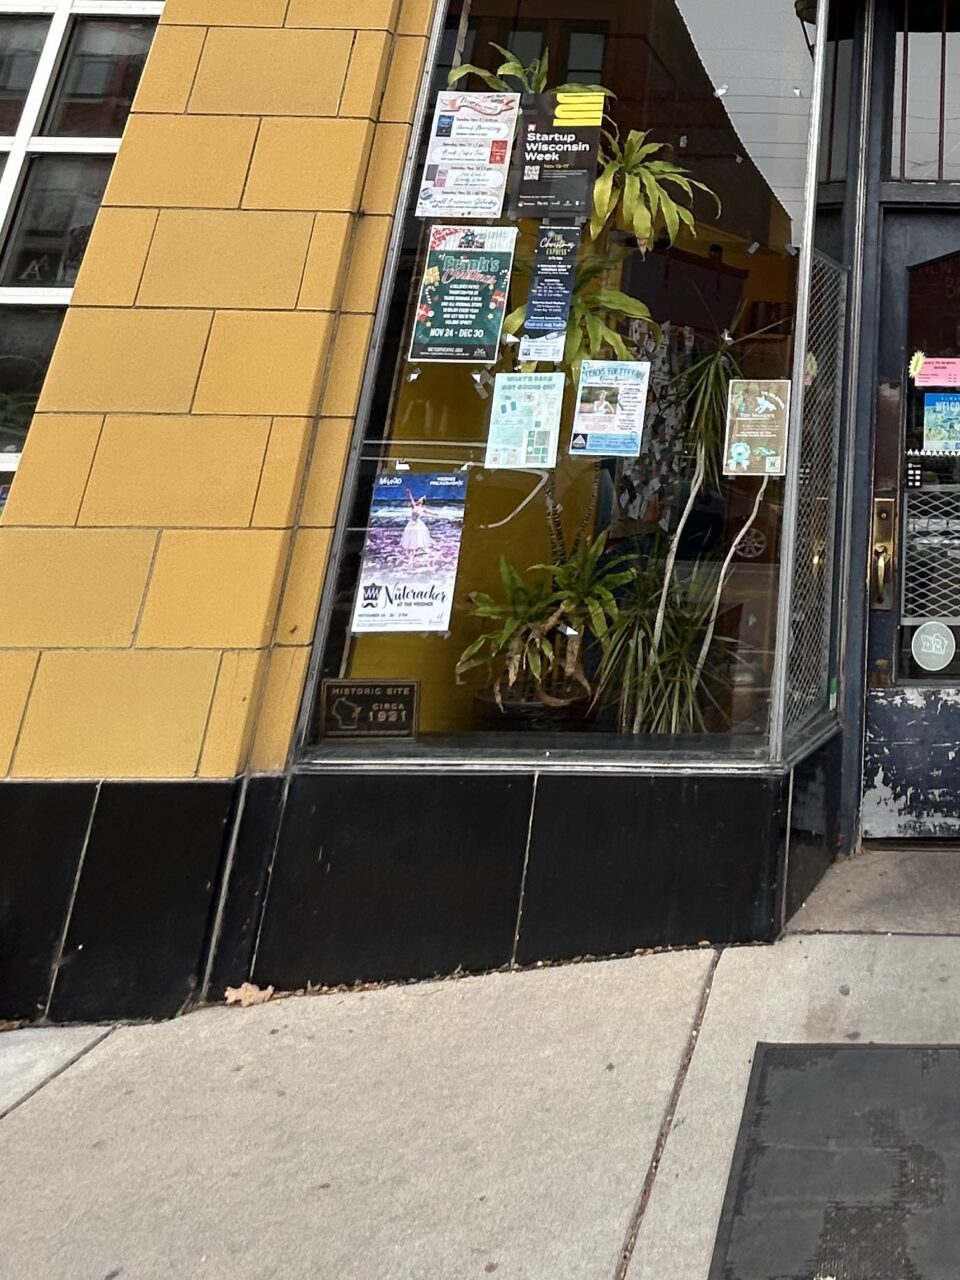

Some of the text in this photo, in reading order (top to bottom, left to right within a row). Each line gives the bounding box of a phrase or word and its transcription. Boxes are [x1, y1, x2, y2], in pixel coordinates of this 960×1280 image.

[527, 133, 576, 143] Startup
[525, 142, 590, 151] Wisconsin
[524, 152, 560, 161] Week
[442, 255, 500, 272] Frank's
[430, 328, 445, 337] NOV
[445, 328, 454, 337] 24
[459, 329, 473, 338] DEC
[474, 329, 484, 338] 30
[383, 582, 447, 609] Nutcracker
[332, 687, 410, 695] HISTORIC SITE
